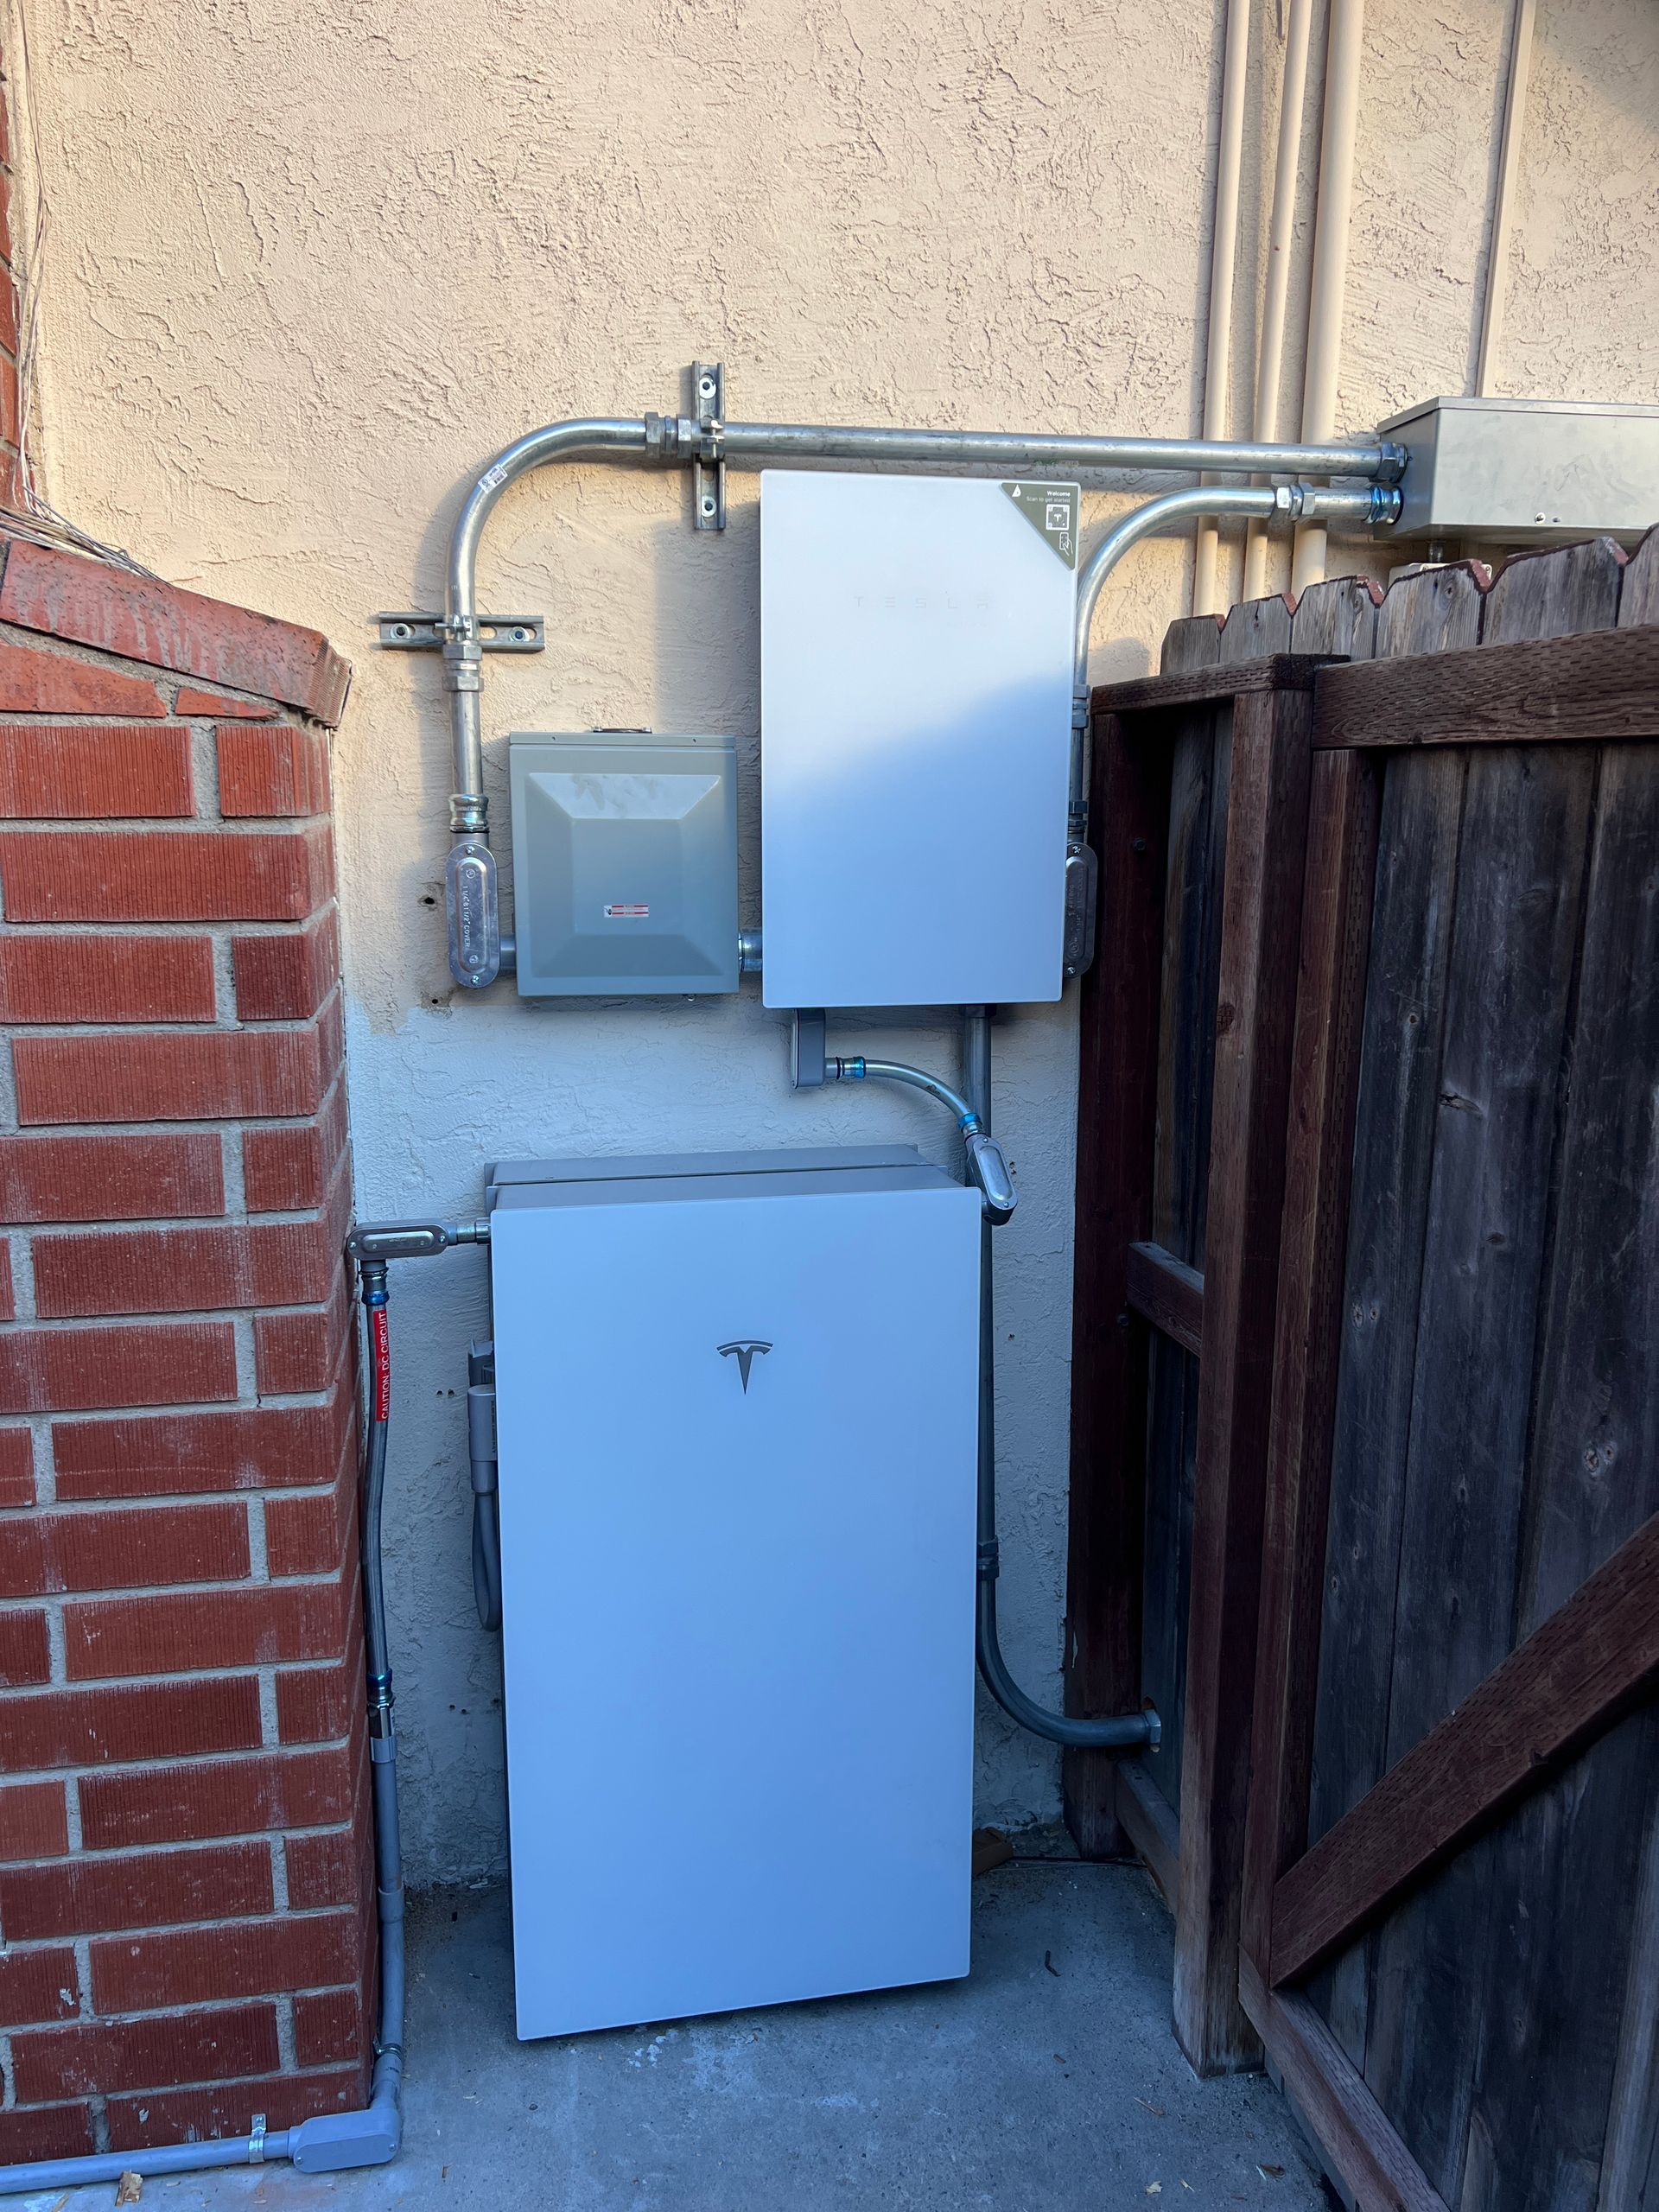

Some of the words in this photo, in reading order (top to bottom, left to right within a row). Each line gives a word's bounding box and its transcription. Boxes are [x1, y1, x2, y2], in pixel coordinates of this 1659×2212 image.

[854, 595, 989, 609] TESLA
[378, 1312, 389, 1353] CIRCUIT
[381, 1355, 389, 1370] DC
